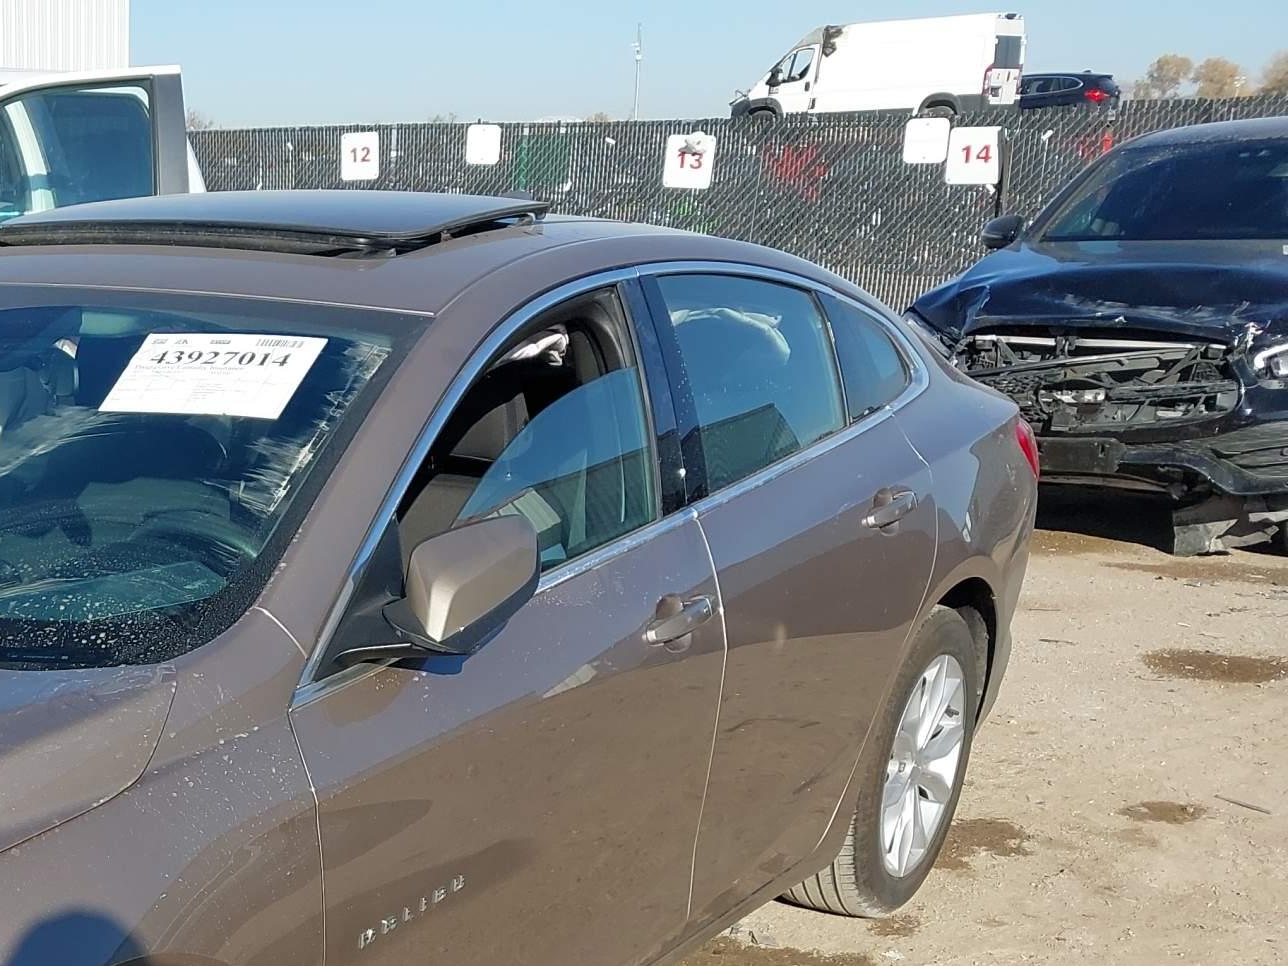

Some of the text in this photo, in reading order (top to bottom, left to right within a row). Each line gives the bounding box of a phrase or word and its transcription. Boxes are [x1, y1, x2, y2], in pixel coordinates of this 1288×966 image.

[350, 146, 371, 163] 12
[678, 151, 703, 169] 13
[961, 145, 992, 163] 14
[150, 350, 292, 367] 43927014
